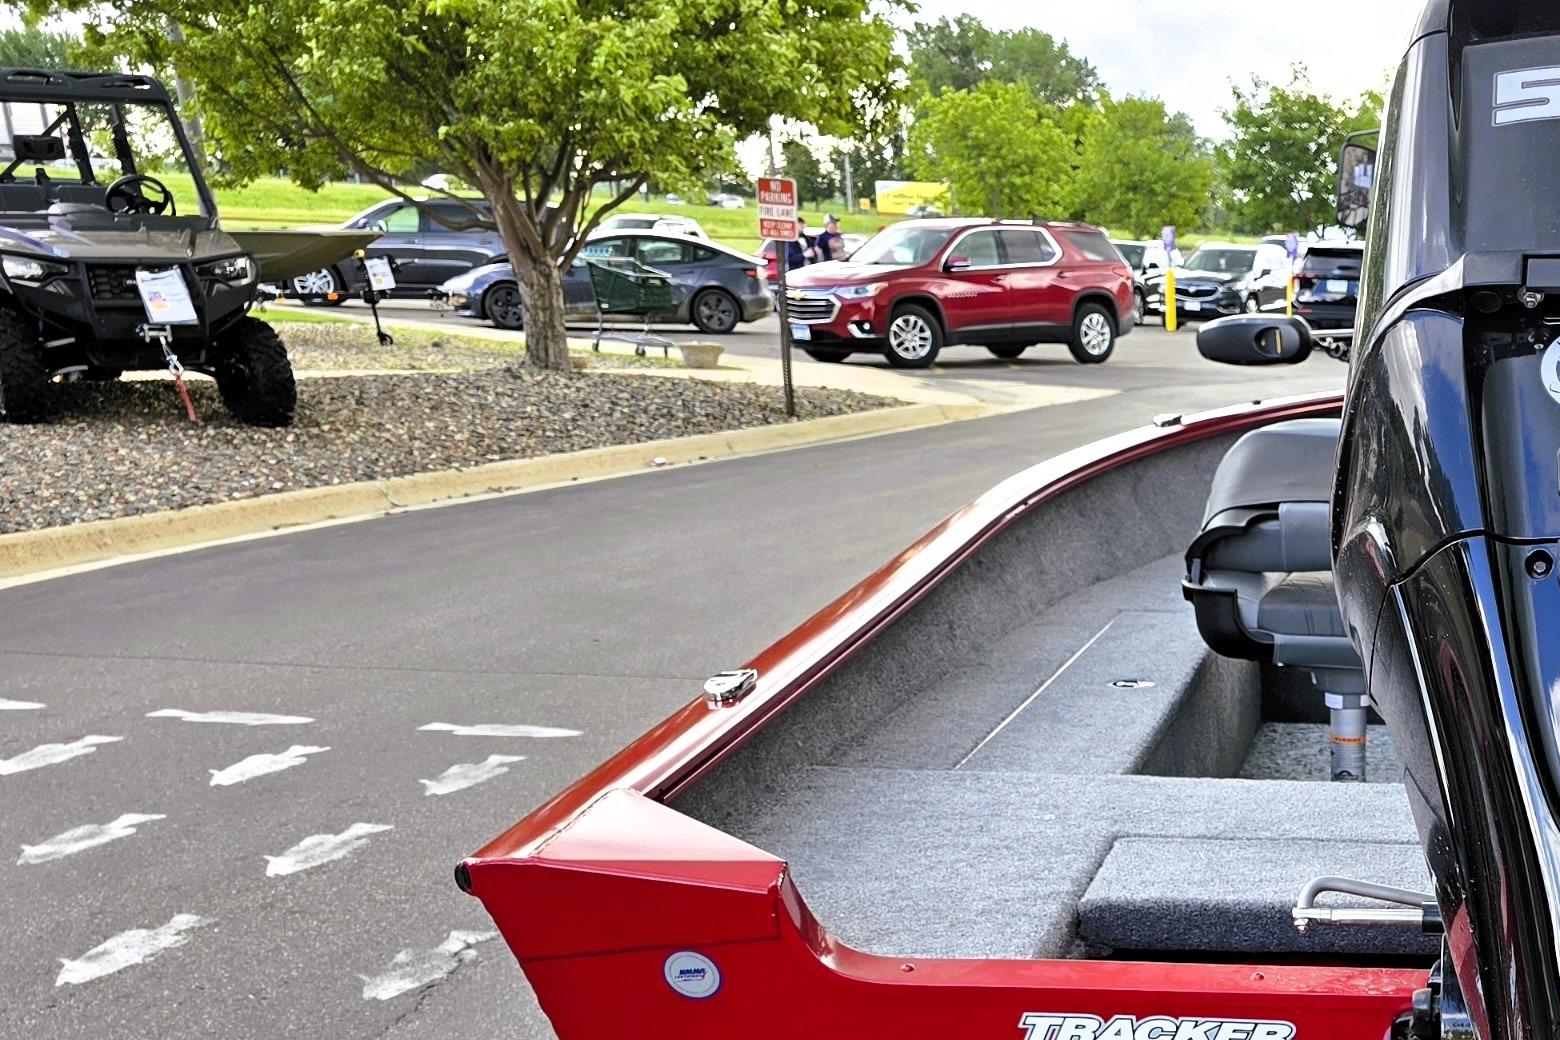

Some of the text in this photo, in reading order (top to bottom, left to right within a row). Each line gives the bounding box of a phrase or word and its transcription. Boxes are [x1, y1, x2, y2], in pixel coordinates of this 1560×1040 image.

[770, 181, 781, 192] NO
[761, 190, 793, 204] PARKING
[760, 206, 794, 219] FIRE LANE
